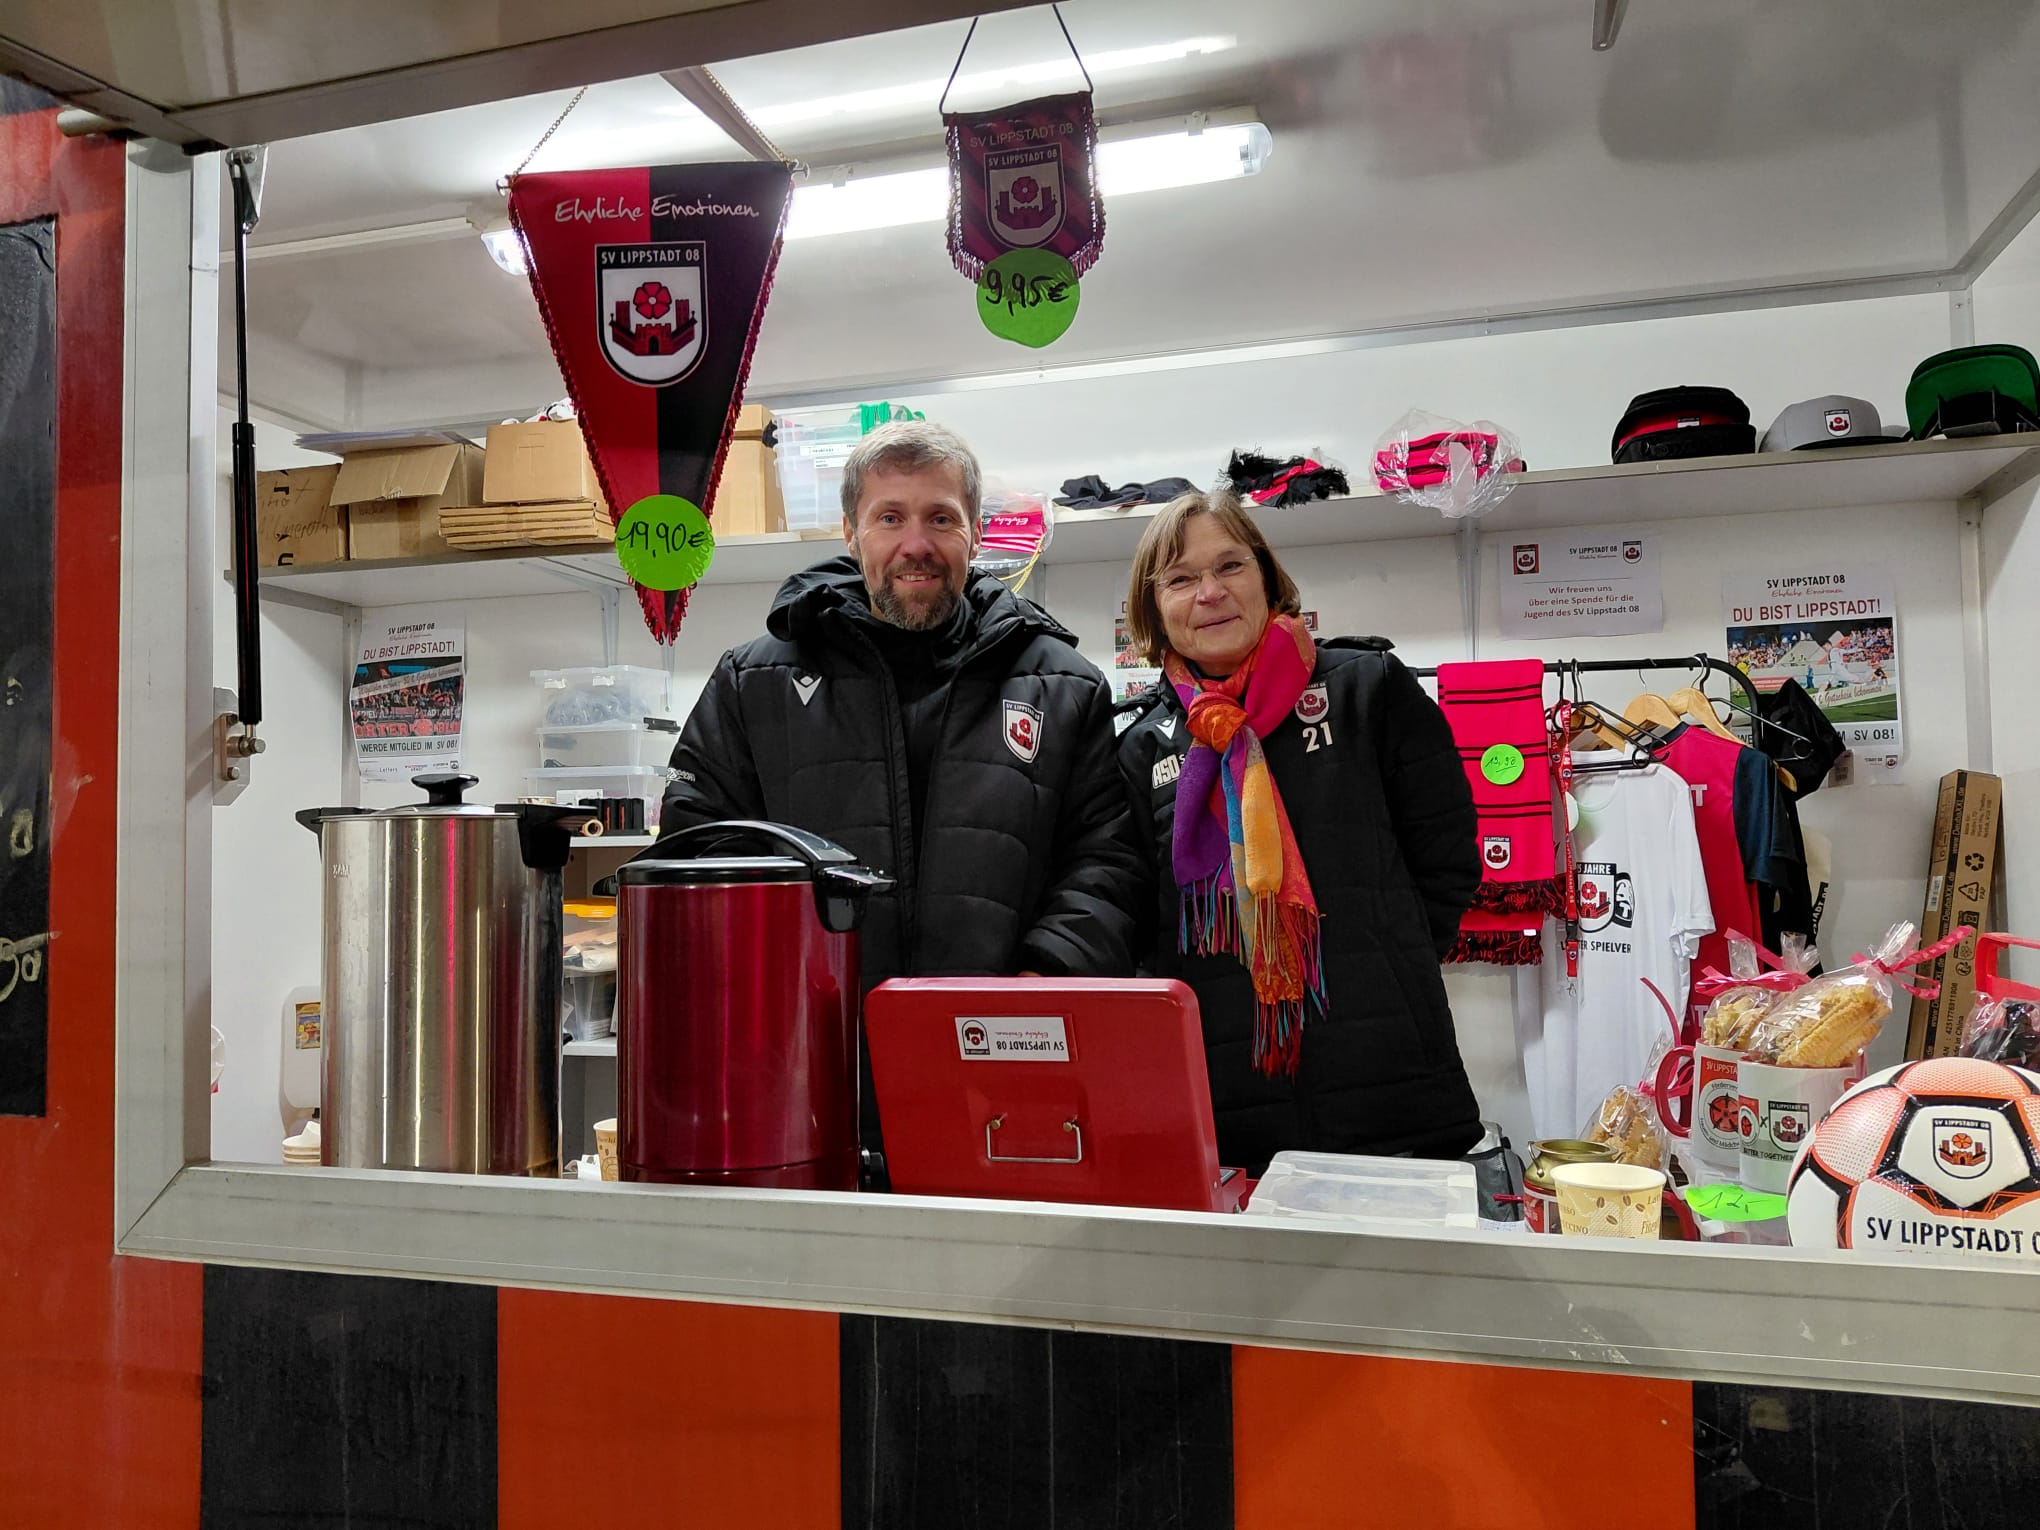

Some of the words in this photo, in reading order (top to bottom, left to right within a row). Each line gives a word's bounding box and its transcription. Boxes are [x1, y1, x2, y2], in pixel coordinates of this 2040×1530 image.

[970, 135, 987, 148] SV
[991, 125, 1054, 146] LIPPSTADT
[1058, 123, 1074, 135] 08
[988, 157, 1000, 167] SV
[1001, 152, 1046, 166] LIPPSTADT
[1047, 150, 1058, 160] 08
[555, 197, 644, 224] Ehrliche
[651, 194, 760, 220] Emotionen
[601, 253, 616, 265] SV
[620, 250, 681, 264] LIPPSTADT
[685, 249, 700, 262] 08
[618, 520, 709, 558] 19,90€
[1578, 546, 1609, 555] LIPPSTADT
[1766, 579, 1779, 589] SV
[1782, 576, 1831, 588] LIPPSTADT
[1833, 574, 1846, 584] 08
[1549, 586, 1564, 594] Wir
[1566, 586, 1595, 594] freuen
[1528, 598, 1549, 607] über
[1551, 597, 1569, 606] eine
[1571, 596, 1604, 606] Spende
[1605, 594, 1618, 603] für
[1620, 594, 1634, 602] die
[1524, 609, 1554, 619] Jugend
[1556, 609, 1571, 617] des
[1573, 608, 1585, 616] SV
[1586, 606, 1626, 616] Lippstadt
[1628, 605, 1640, 613] 08
[1733, 608, 1753, 622] DU
[1760, 605, 1792, 621] BIST
[1797, 598, 1881, 618] LIPPSTADT!
[388, 626, 396, 635] SV
[397, 623, 426, 634] LIPPSTADT
[364, 649, 377, 660] DU
[379, 646, 400, 658] BIST
[400, 641, 455, 656] LIPPSTADT!
[1302, 721, 1333, 753] 21
[1854, 729, 1868, 741] SV
[1873, 728, 1896, 741] 08!
[361, 742, 388, 753] WERDE
[389, 741, 422, 752] MITGLIED
[424, 741, 433, 750] IM
[436, 741, 445, 749] SV
[1583, 863, 1611, 875] JAHRE
[996, 1040, 1007, 1050] 08
[1009, 1040, 1051, 1051] LIPPSTADT
[1053, 1041, 1065, 1051] SV
[1713, 1063, 1738, 1075] LIPPSTA
[1867, 1216, 1892, 1241] SV
[1900, 1220, 2024, 1254] LIPPSTADT
